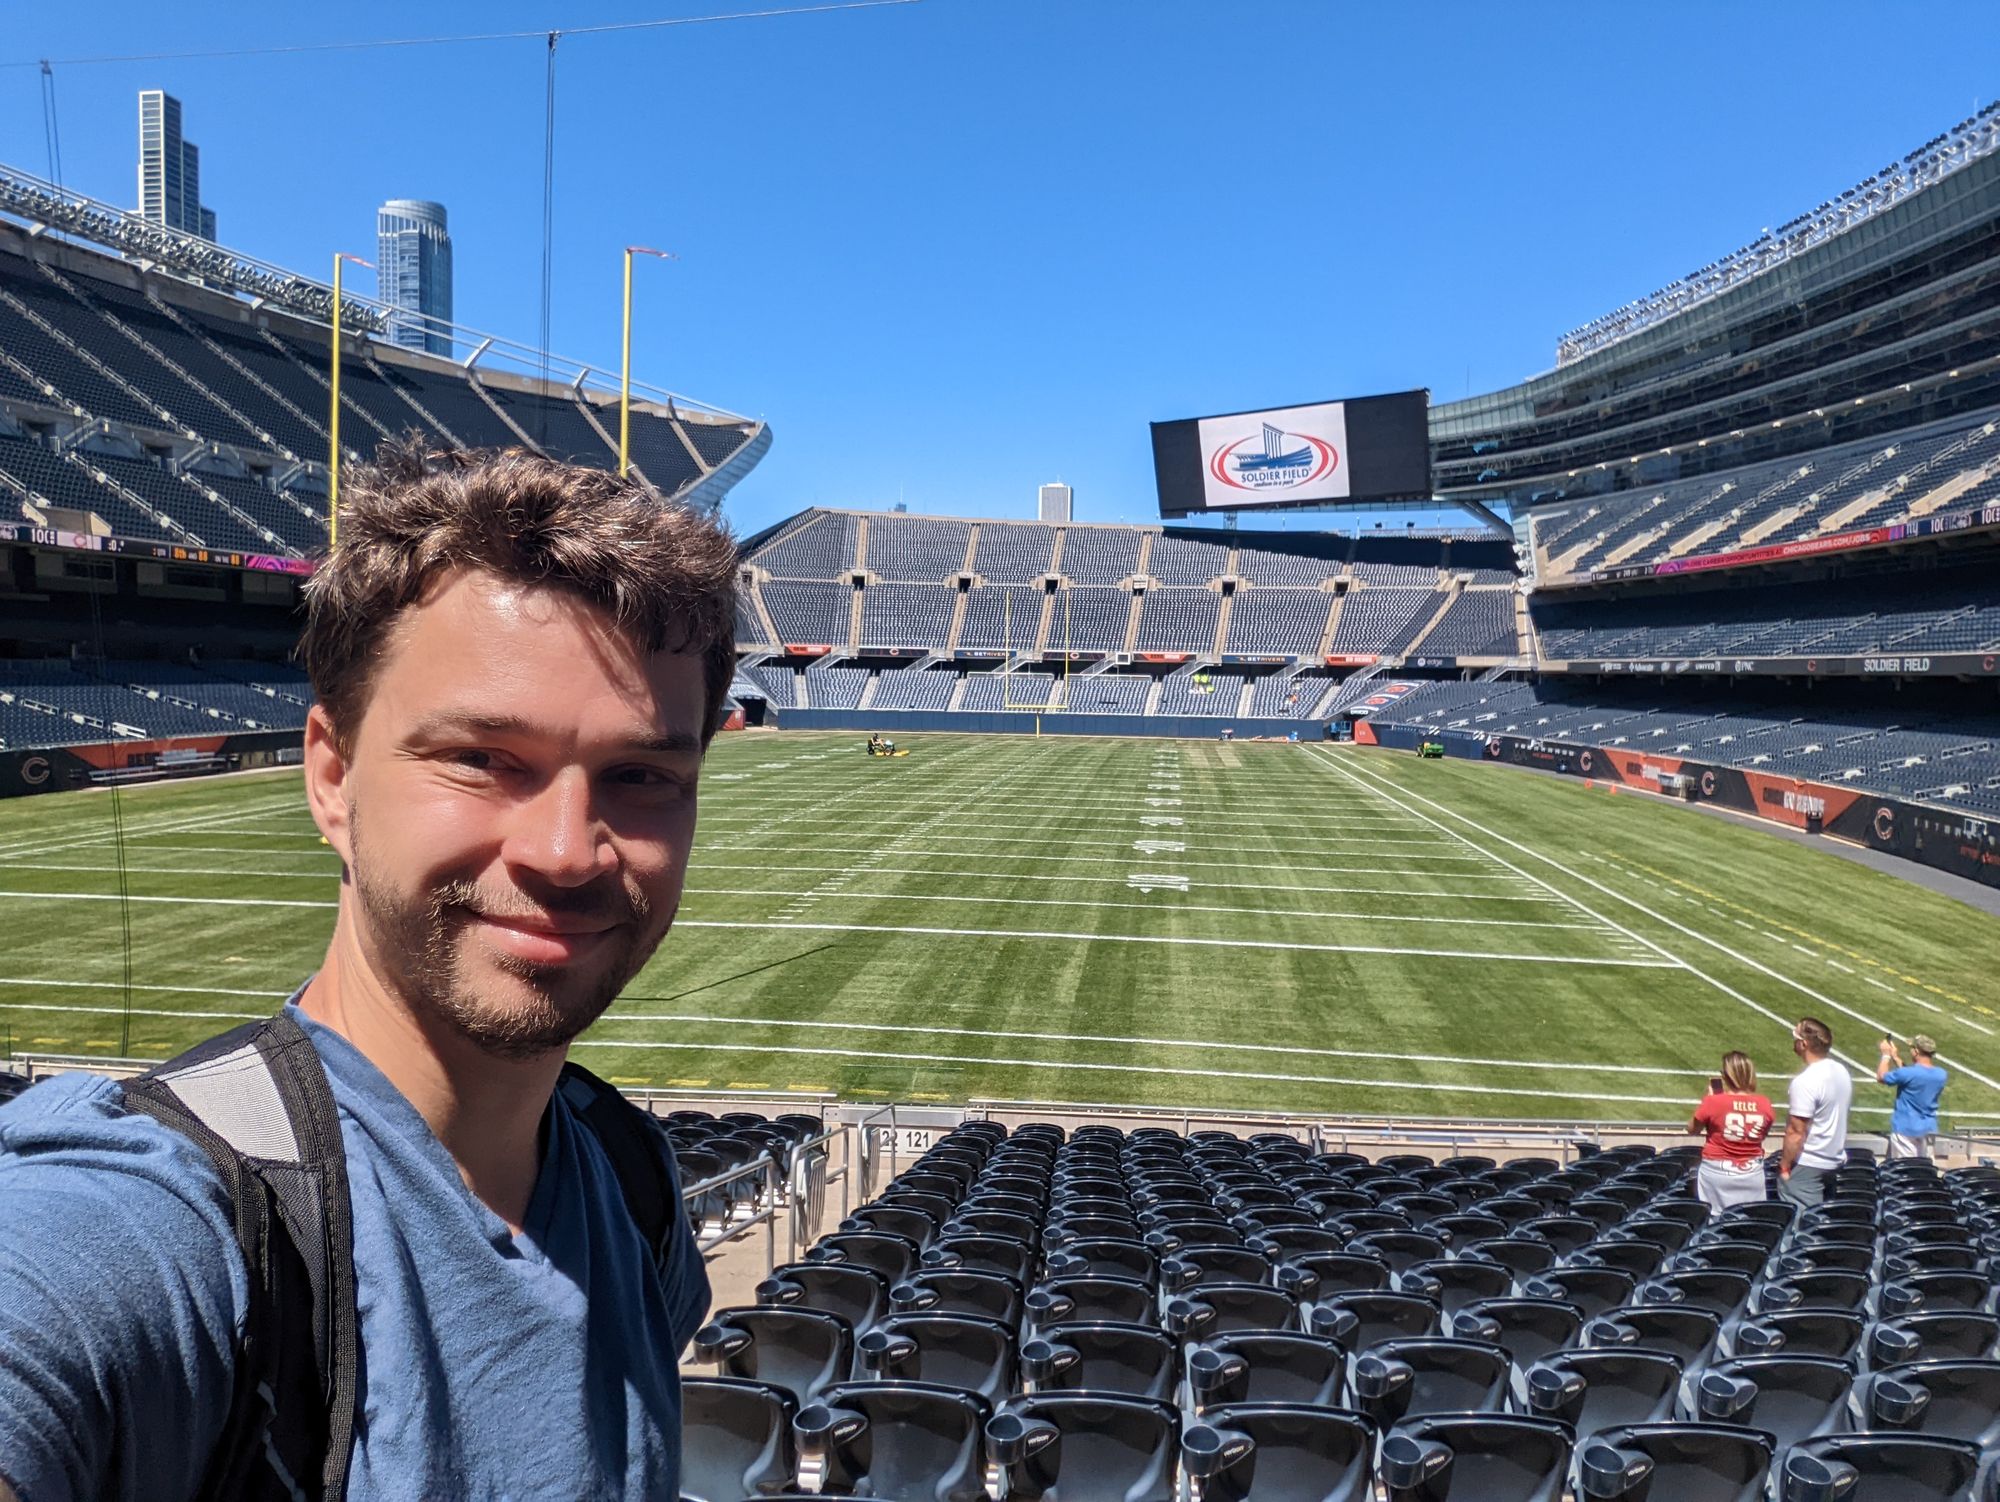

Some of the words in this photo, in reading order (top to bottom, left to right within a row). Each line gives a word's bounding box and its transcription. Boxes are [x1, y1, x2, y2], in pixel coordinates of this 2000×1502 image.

[1241, 470, 1280, 483] SOLDIER
[1283, 467, 1309, 480] FIELD
[1783, 533, 1871, 555] CHICAGOBEARS.COM/JOBS
[1864, 658, 1900, 672] SOLDIER
[1904, 657, 1930, 672] FIELD
[1733, 1101, 1757, 1112] KELCE
[1724, 1113, 1764, 1142] 87
[906, 1130, 929, 1147] 121
[1028, 1434, 1049, 1446] verizon
[1224, 1445, 1244, 1457] verizon
